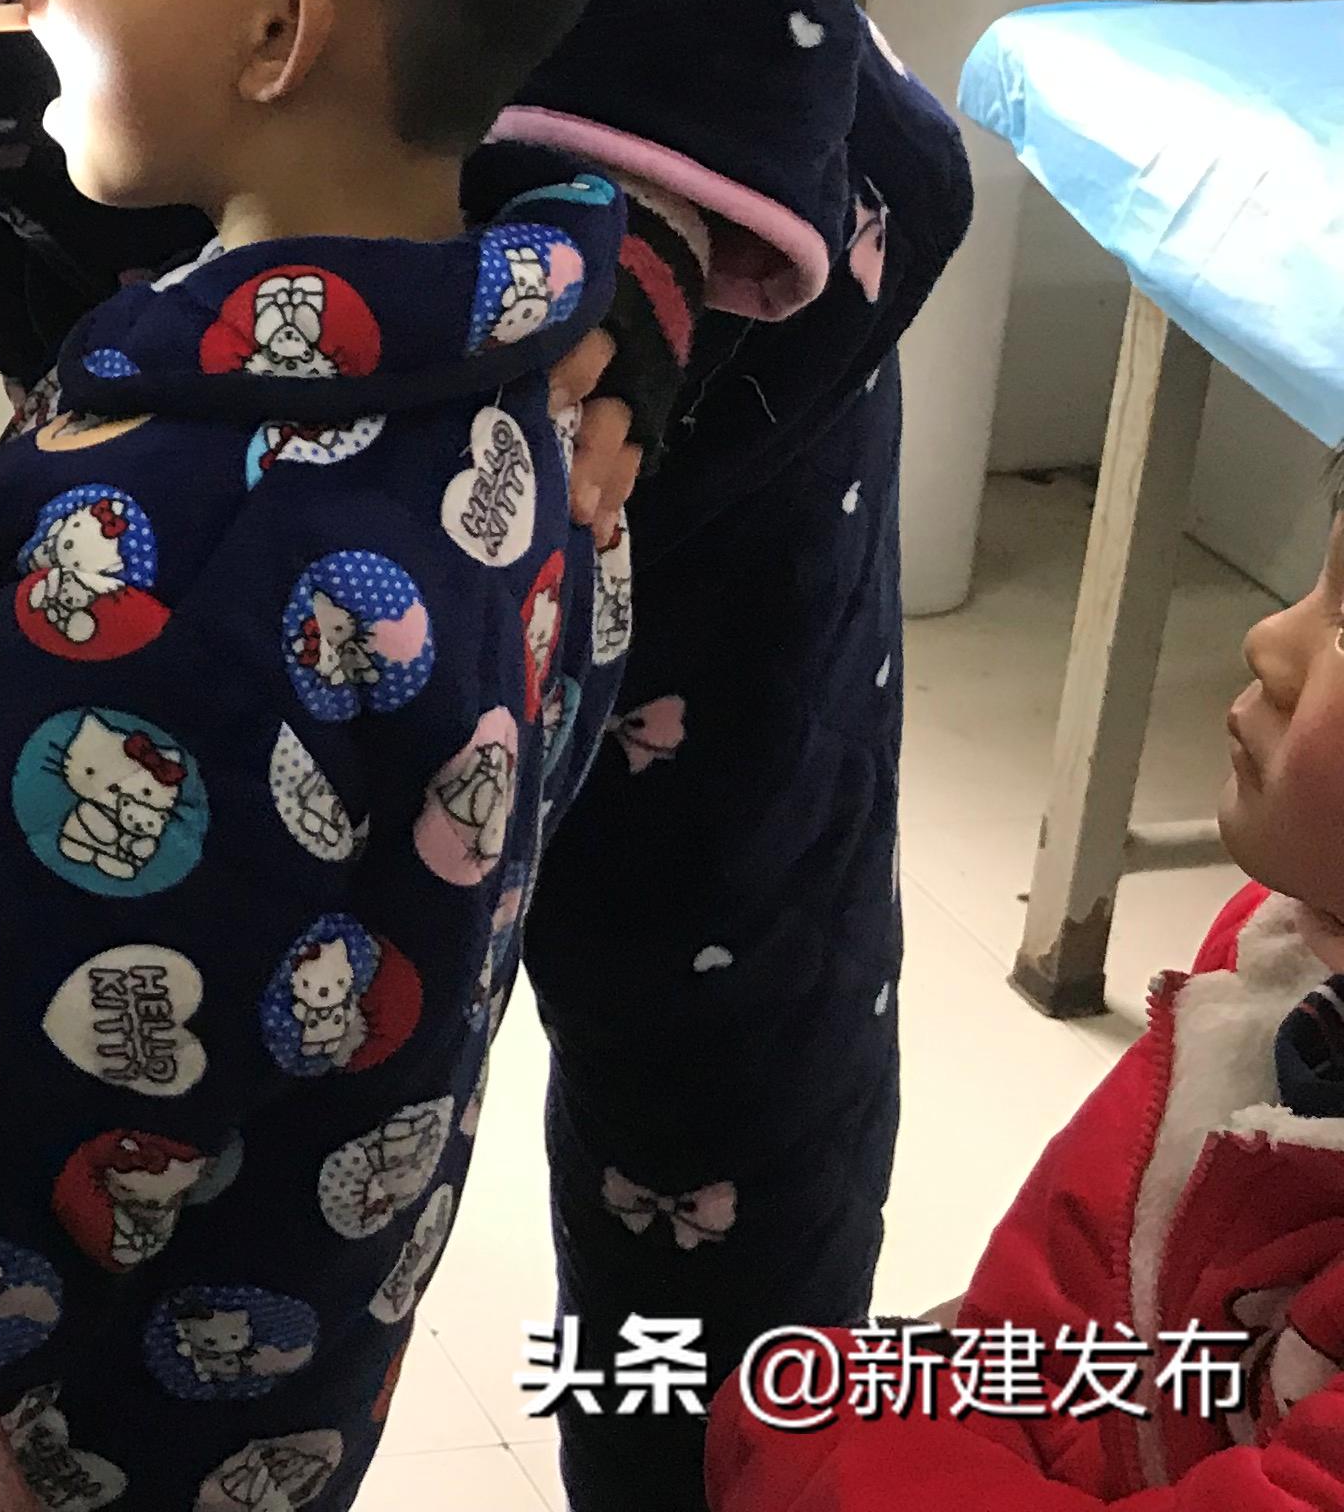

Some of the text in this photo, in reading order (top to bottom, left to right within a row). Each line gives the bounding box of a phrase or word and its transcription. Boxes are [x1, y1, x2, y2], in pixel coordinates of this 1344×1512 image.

[461, 419, 513, 538] HELLO
[484, 440, 530, 557] KITTY
[88, 967, 141, 1081] KITTY
[128, 965, 178, 1084] HELLO
